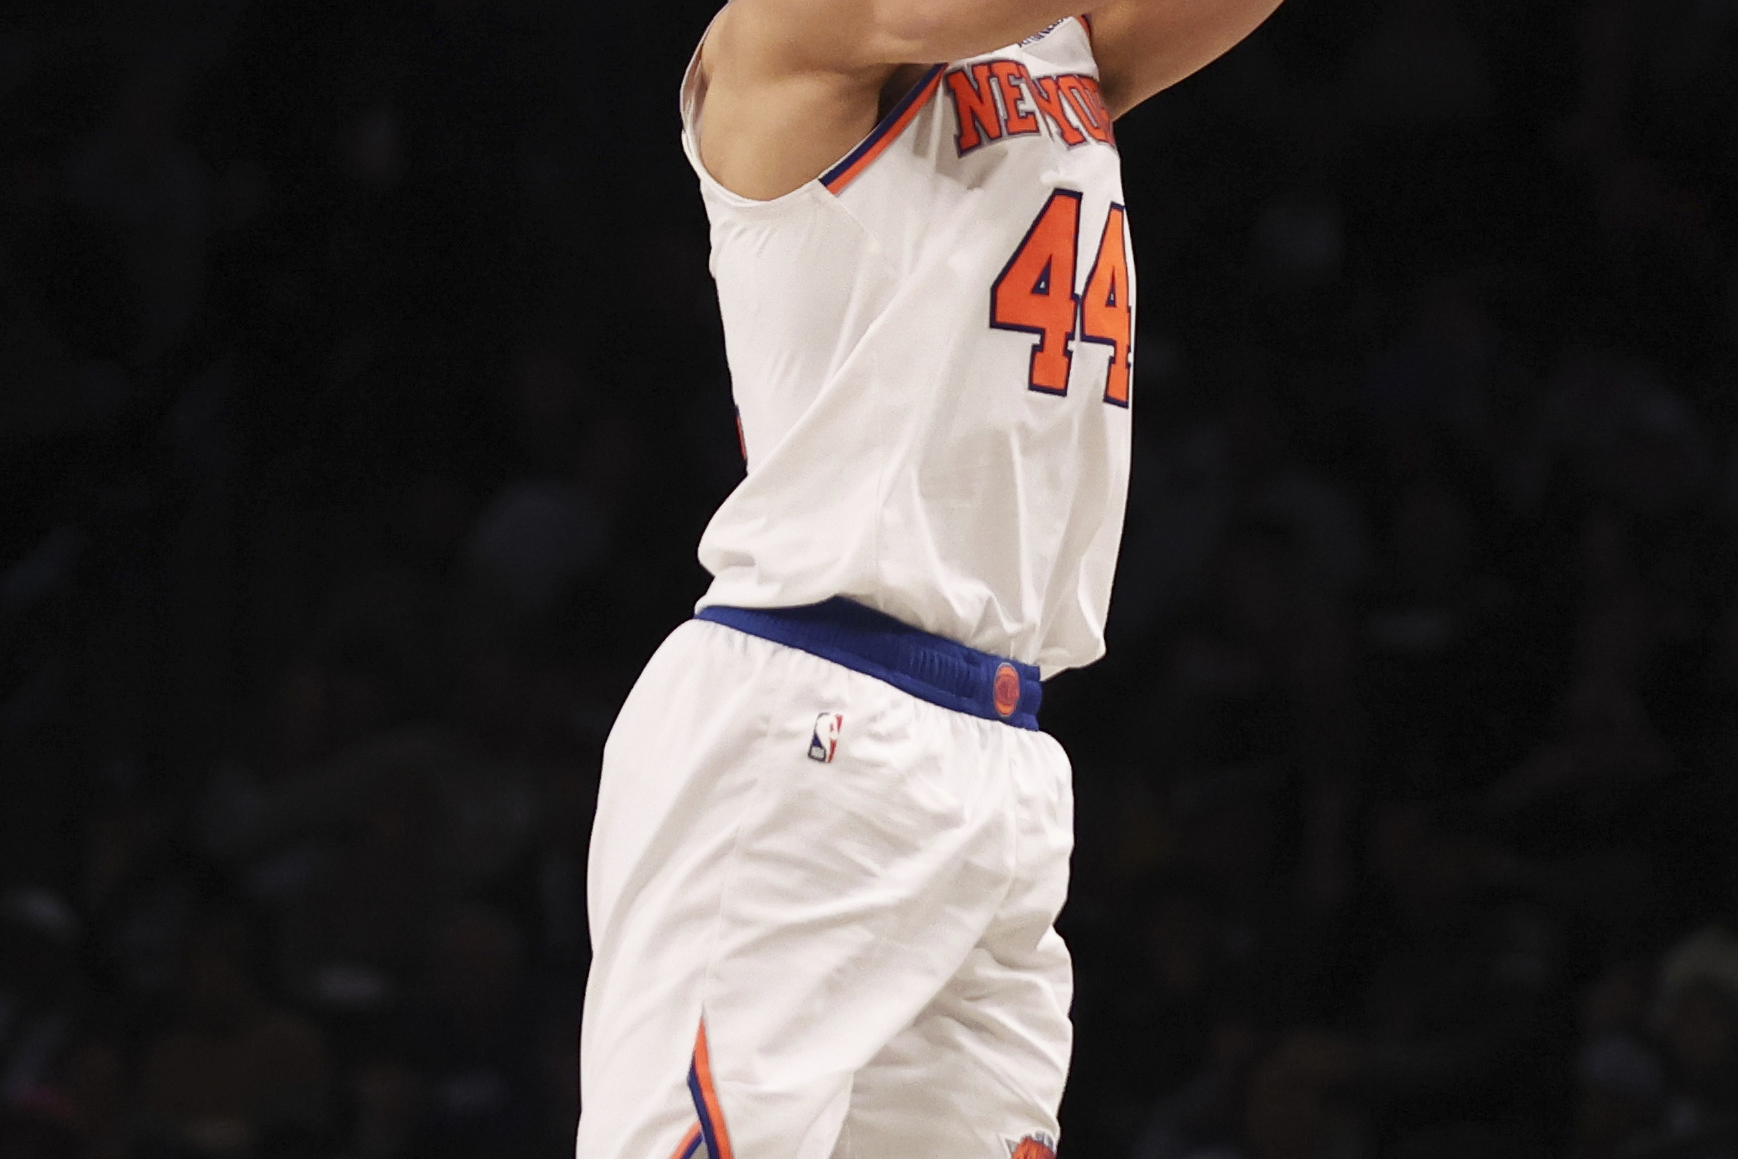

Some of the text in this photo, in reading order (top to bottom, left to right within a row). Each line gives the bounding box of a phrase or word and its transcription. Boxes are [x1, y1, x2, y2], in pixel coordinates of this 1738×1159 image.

[944, 59, 1118, 158] NE YO
[989, 187, 1132, 408] 44
